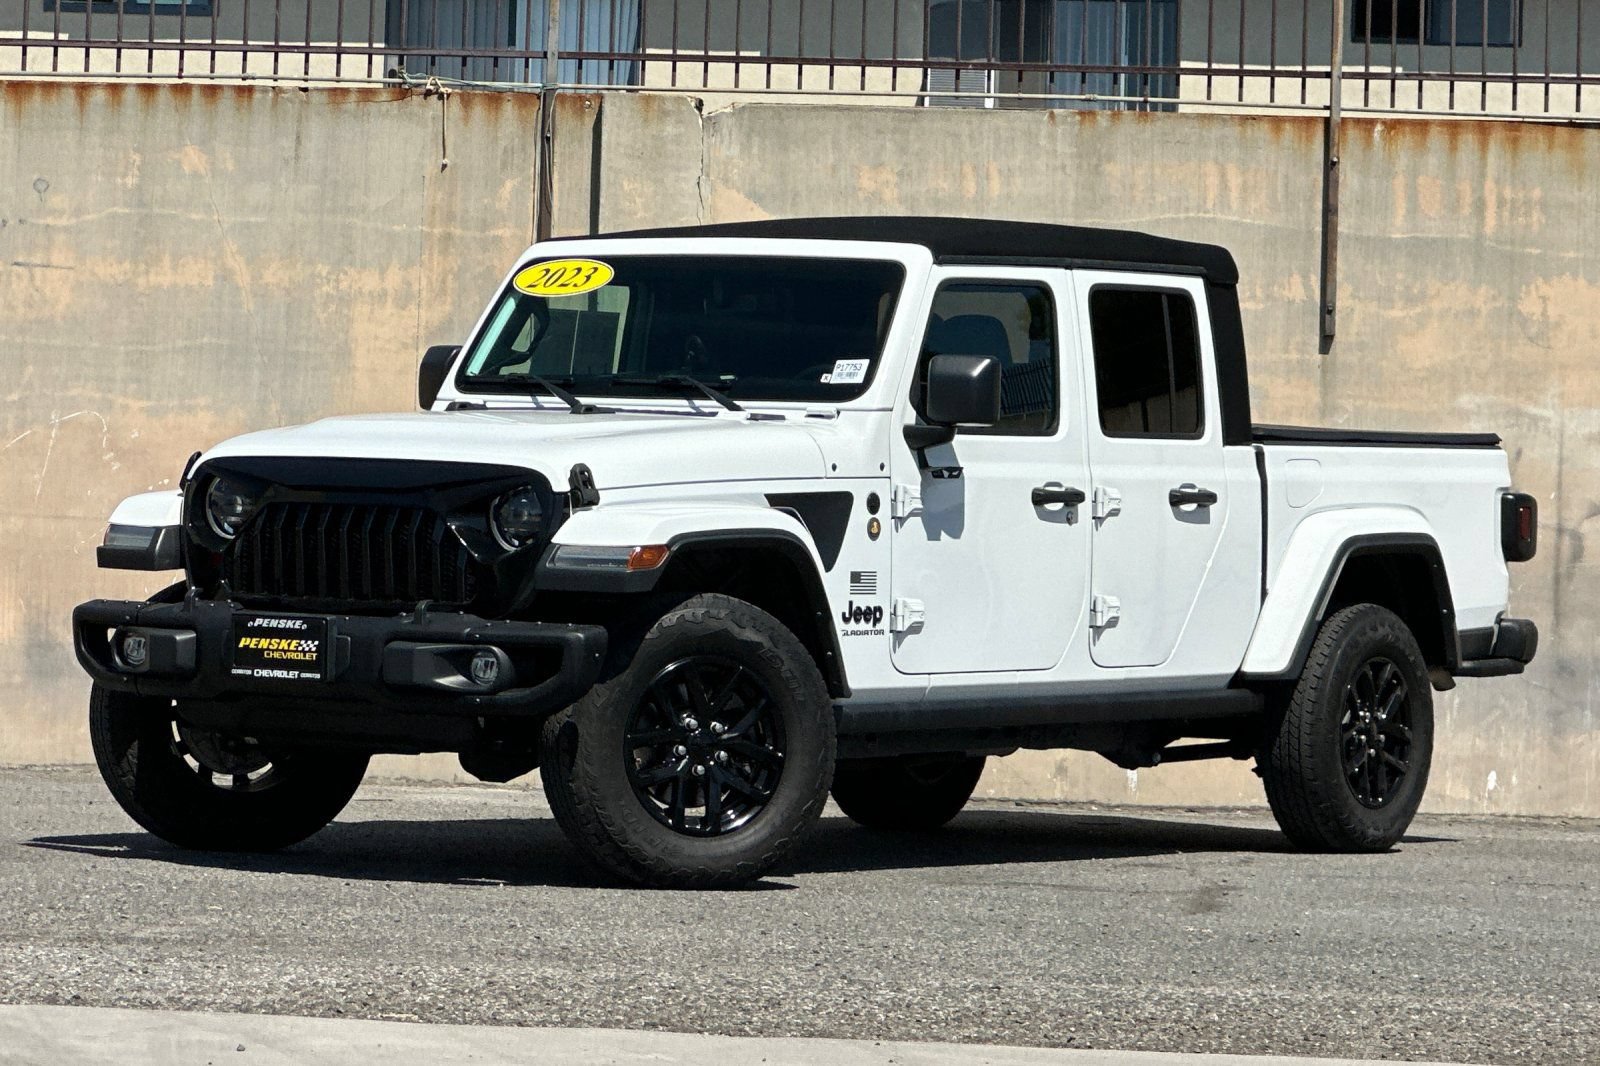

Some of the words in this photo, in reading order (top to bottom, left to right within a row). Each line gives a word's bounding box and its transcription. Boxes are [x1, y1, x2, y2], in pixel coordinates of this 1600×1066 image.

[525, 266, 599, 288] 2023
[836, 363, 863, 371] P17753
[841, 600, 884, 628] Jeep
[253, 618, 303, 629] PENSKE
[238, 637, 300, 651] PENSKE
[263, 650, 318, 660] CHEVROLET
[253, 668, 300, 679] CHEVROLET
